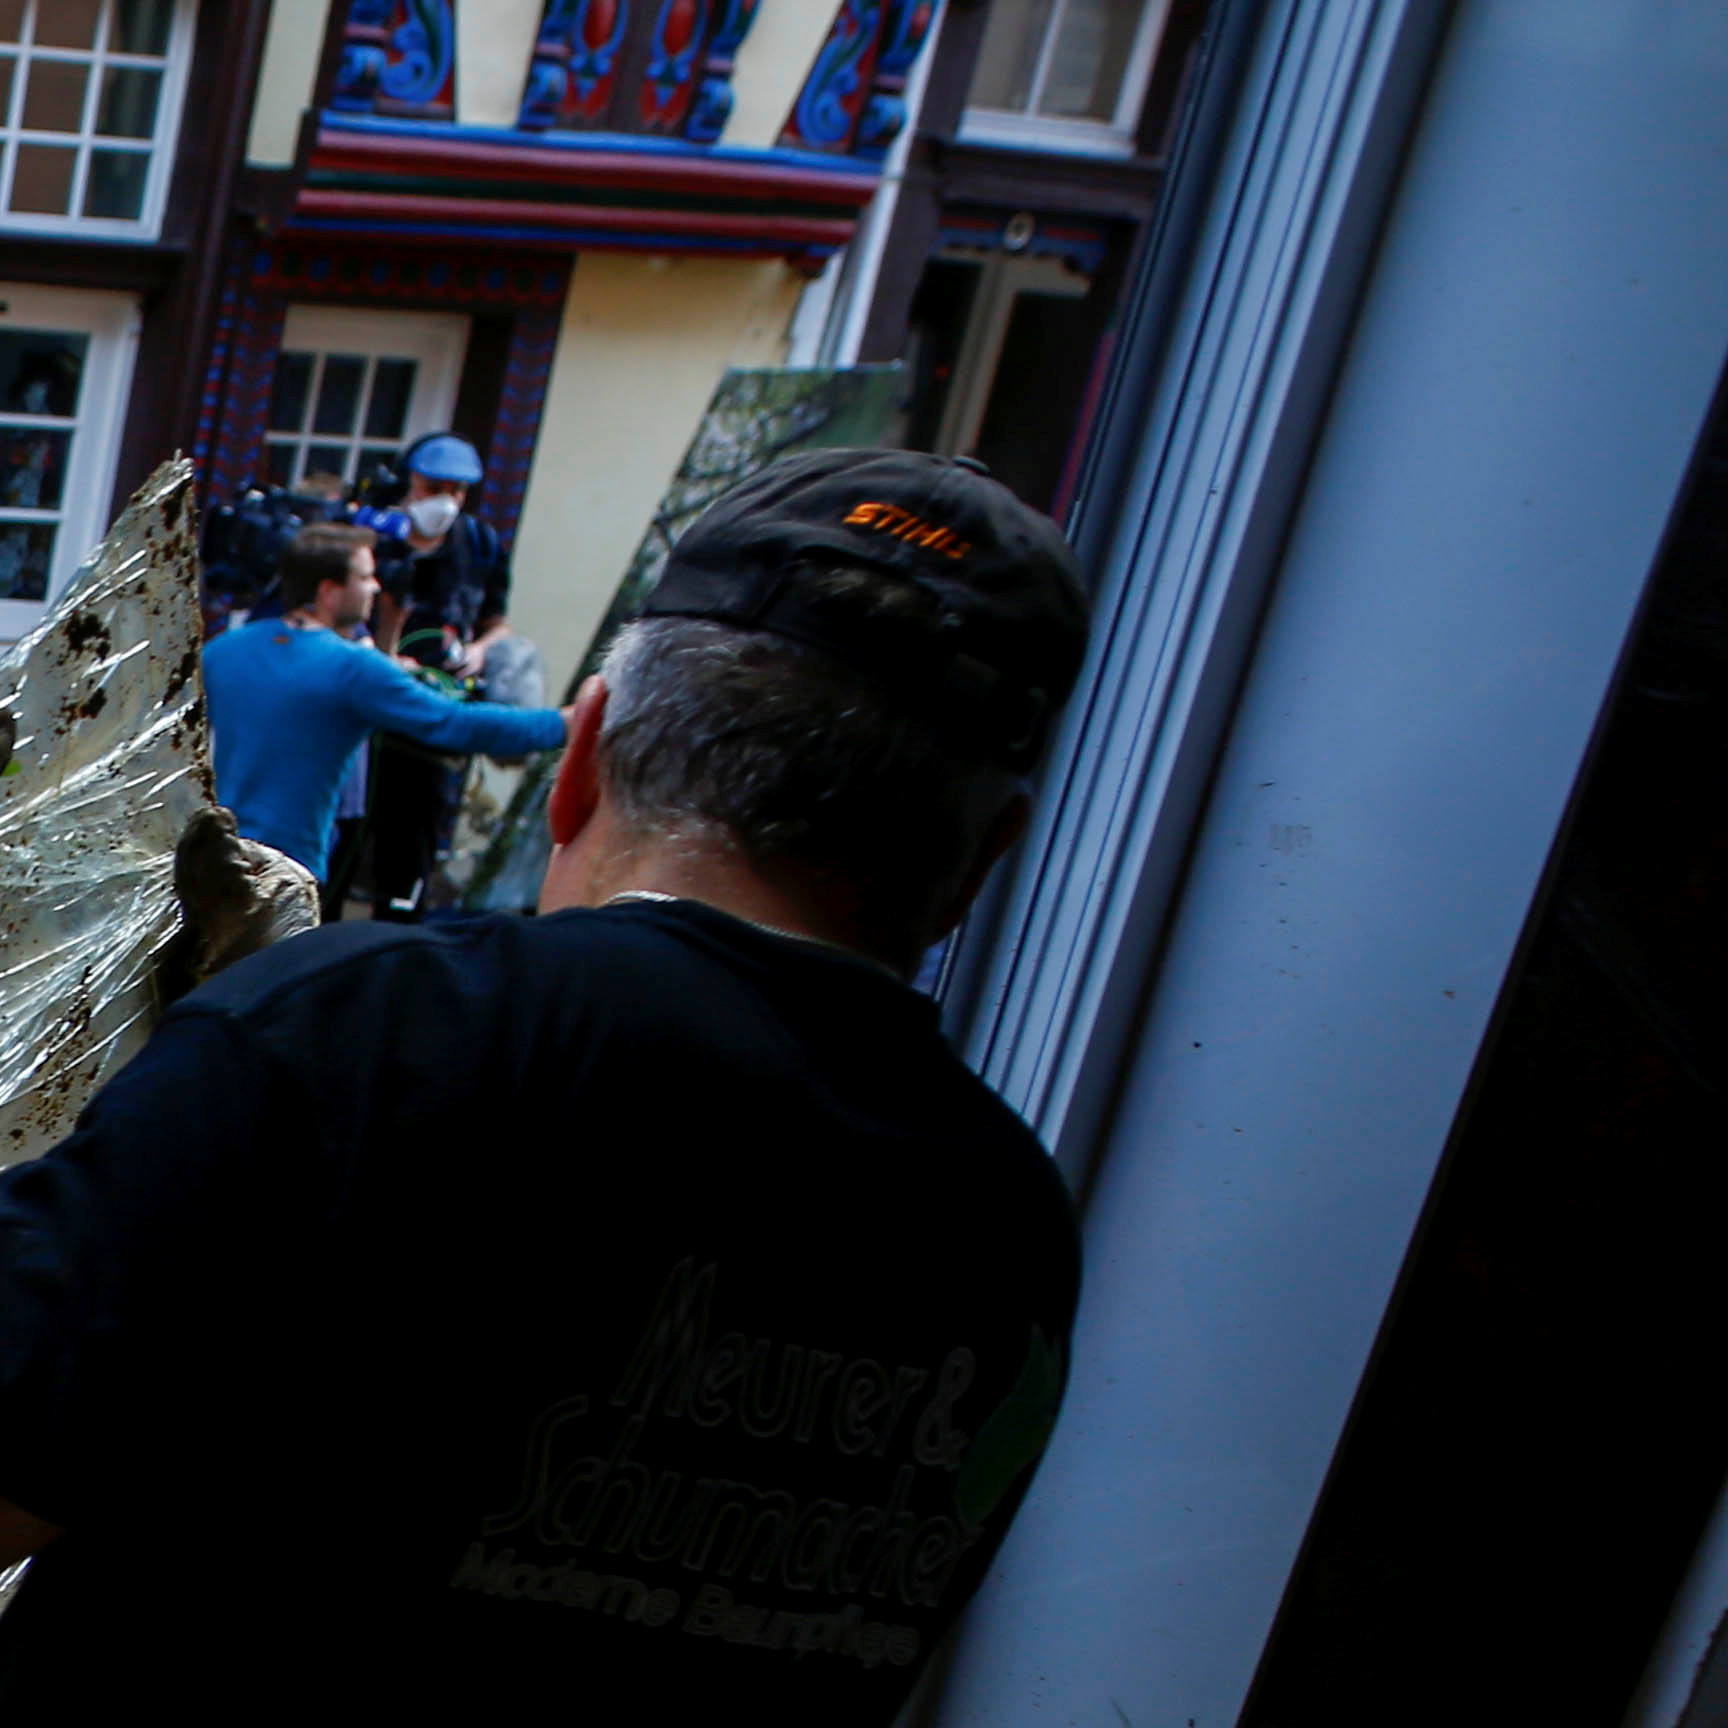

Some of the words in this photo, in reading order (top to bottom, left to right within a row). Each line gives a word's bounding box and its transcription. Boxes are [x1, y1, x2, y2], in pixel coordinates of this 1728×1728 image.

[842, 501, 972, 560] STIHL
[609, 1254, 928, 1458] Meurer
[912, 1345, 977, 1472] &
[482, 1393, 987, 1607] Schumacher
[449, 1541, 681, 1629] Moderne
